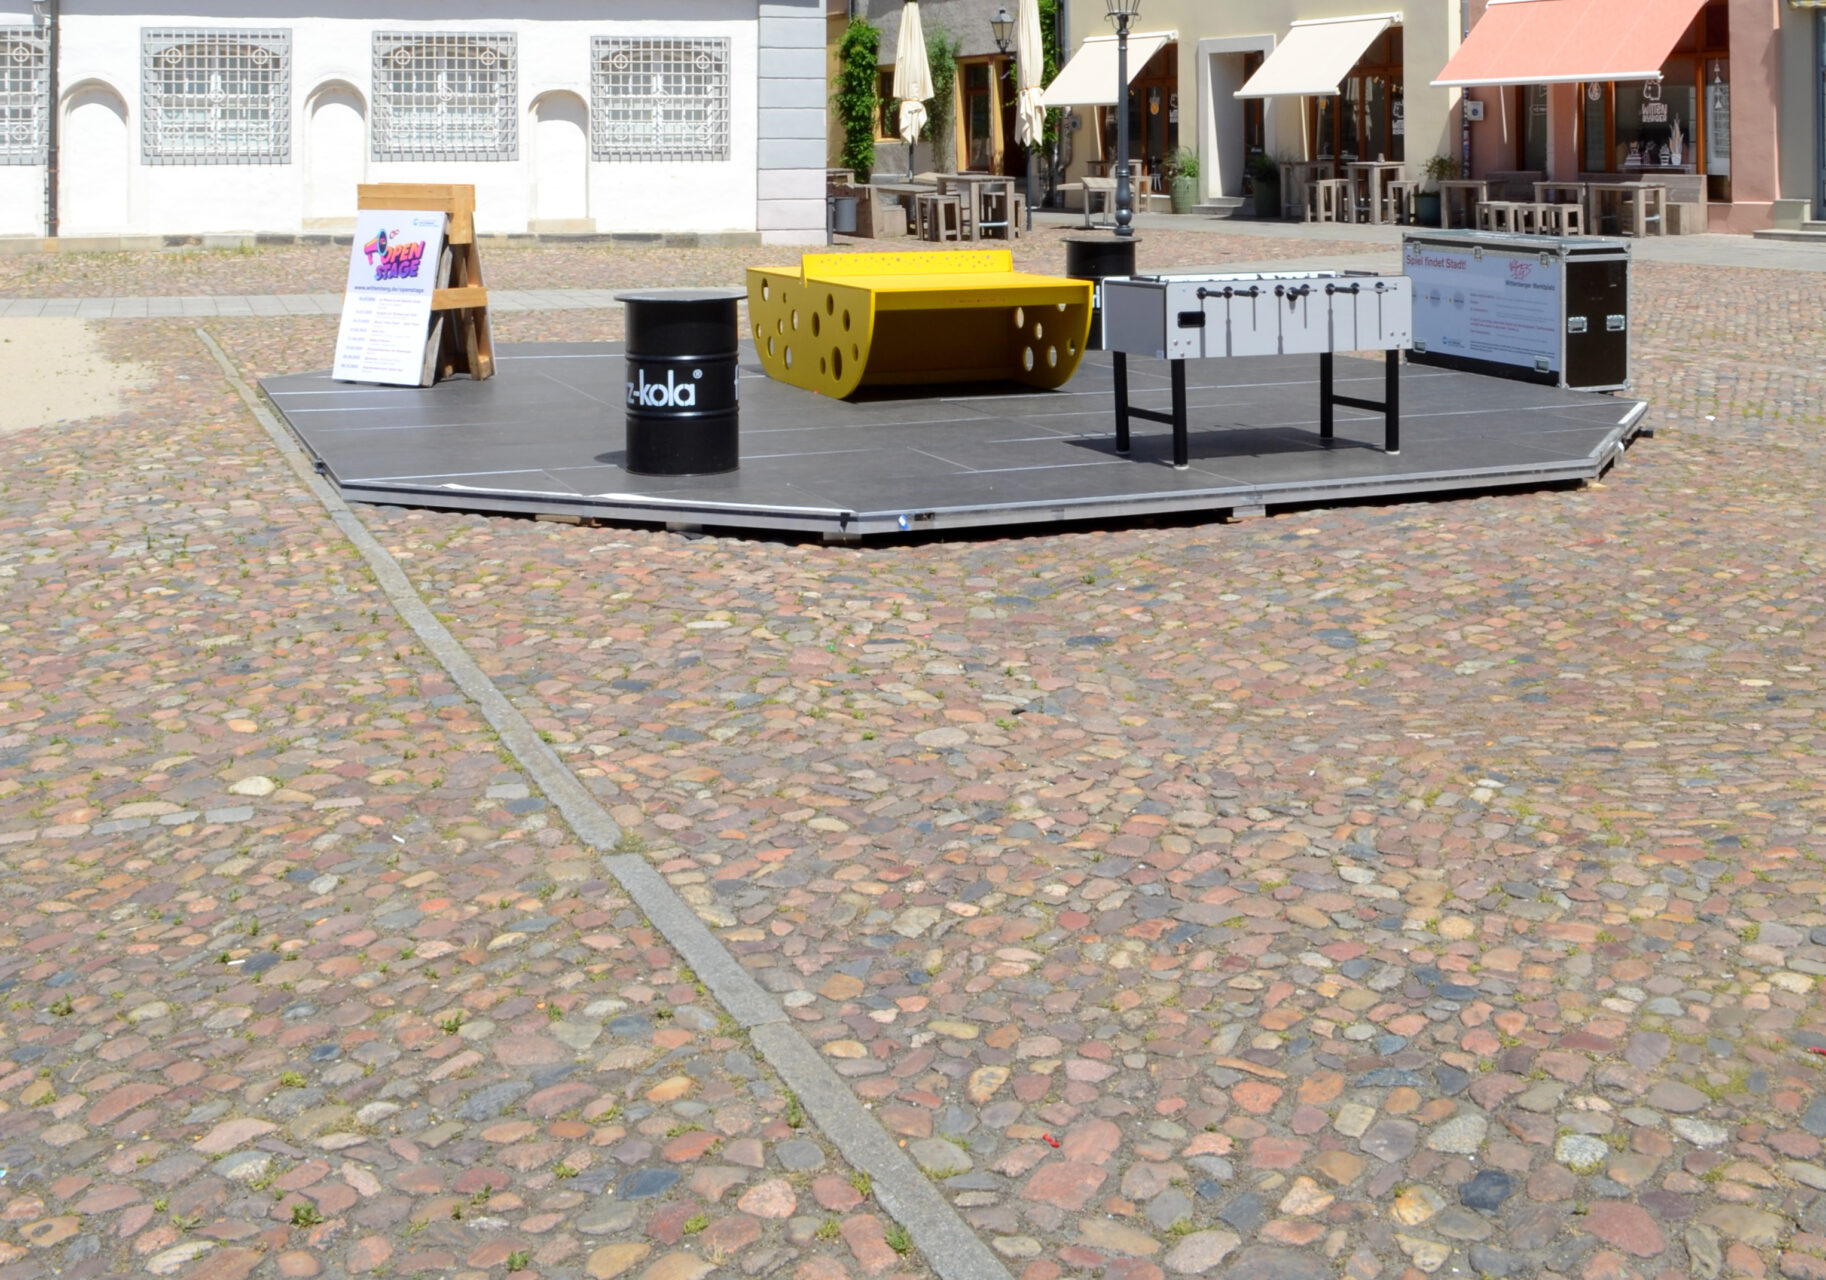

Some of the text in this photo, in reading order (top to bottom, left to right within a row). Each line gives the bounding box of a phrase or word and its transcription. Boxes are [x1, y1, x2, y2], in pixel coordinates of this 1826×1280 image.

[380, 240, 426, 266] OPEN
[1406, 254, 1424, 266] Spiel
[1424, 256, 1445, 268] findet
[374, 259, 421, 281] STAGE
